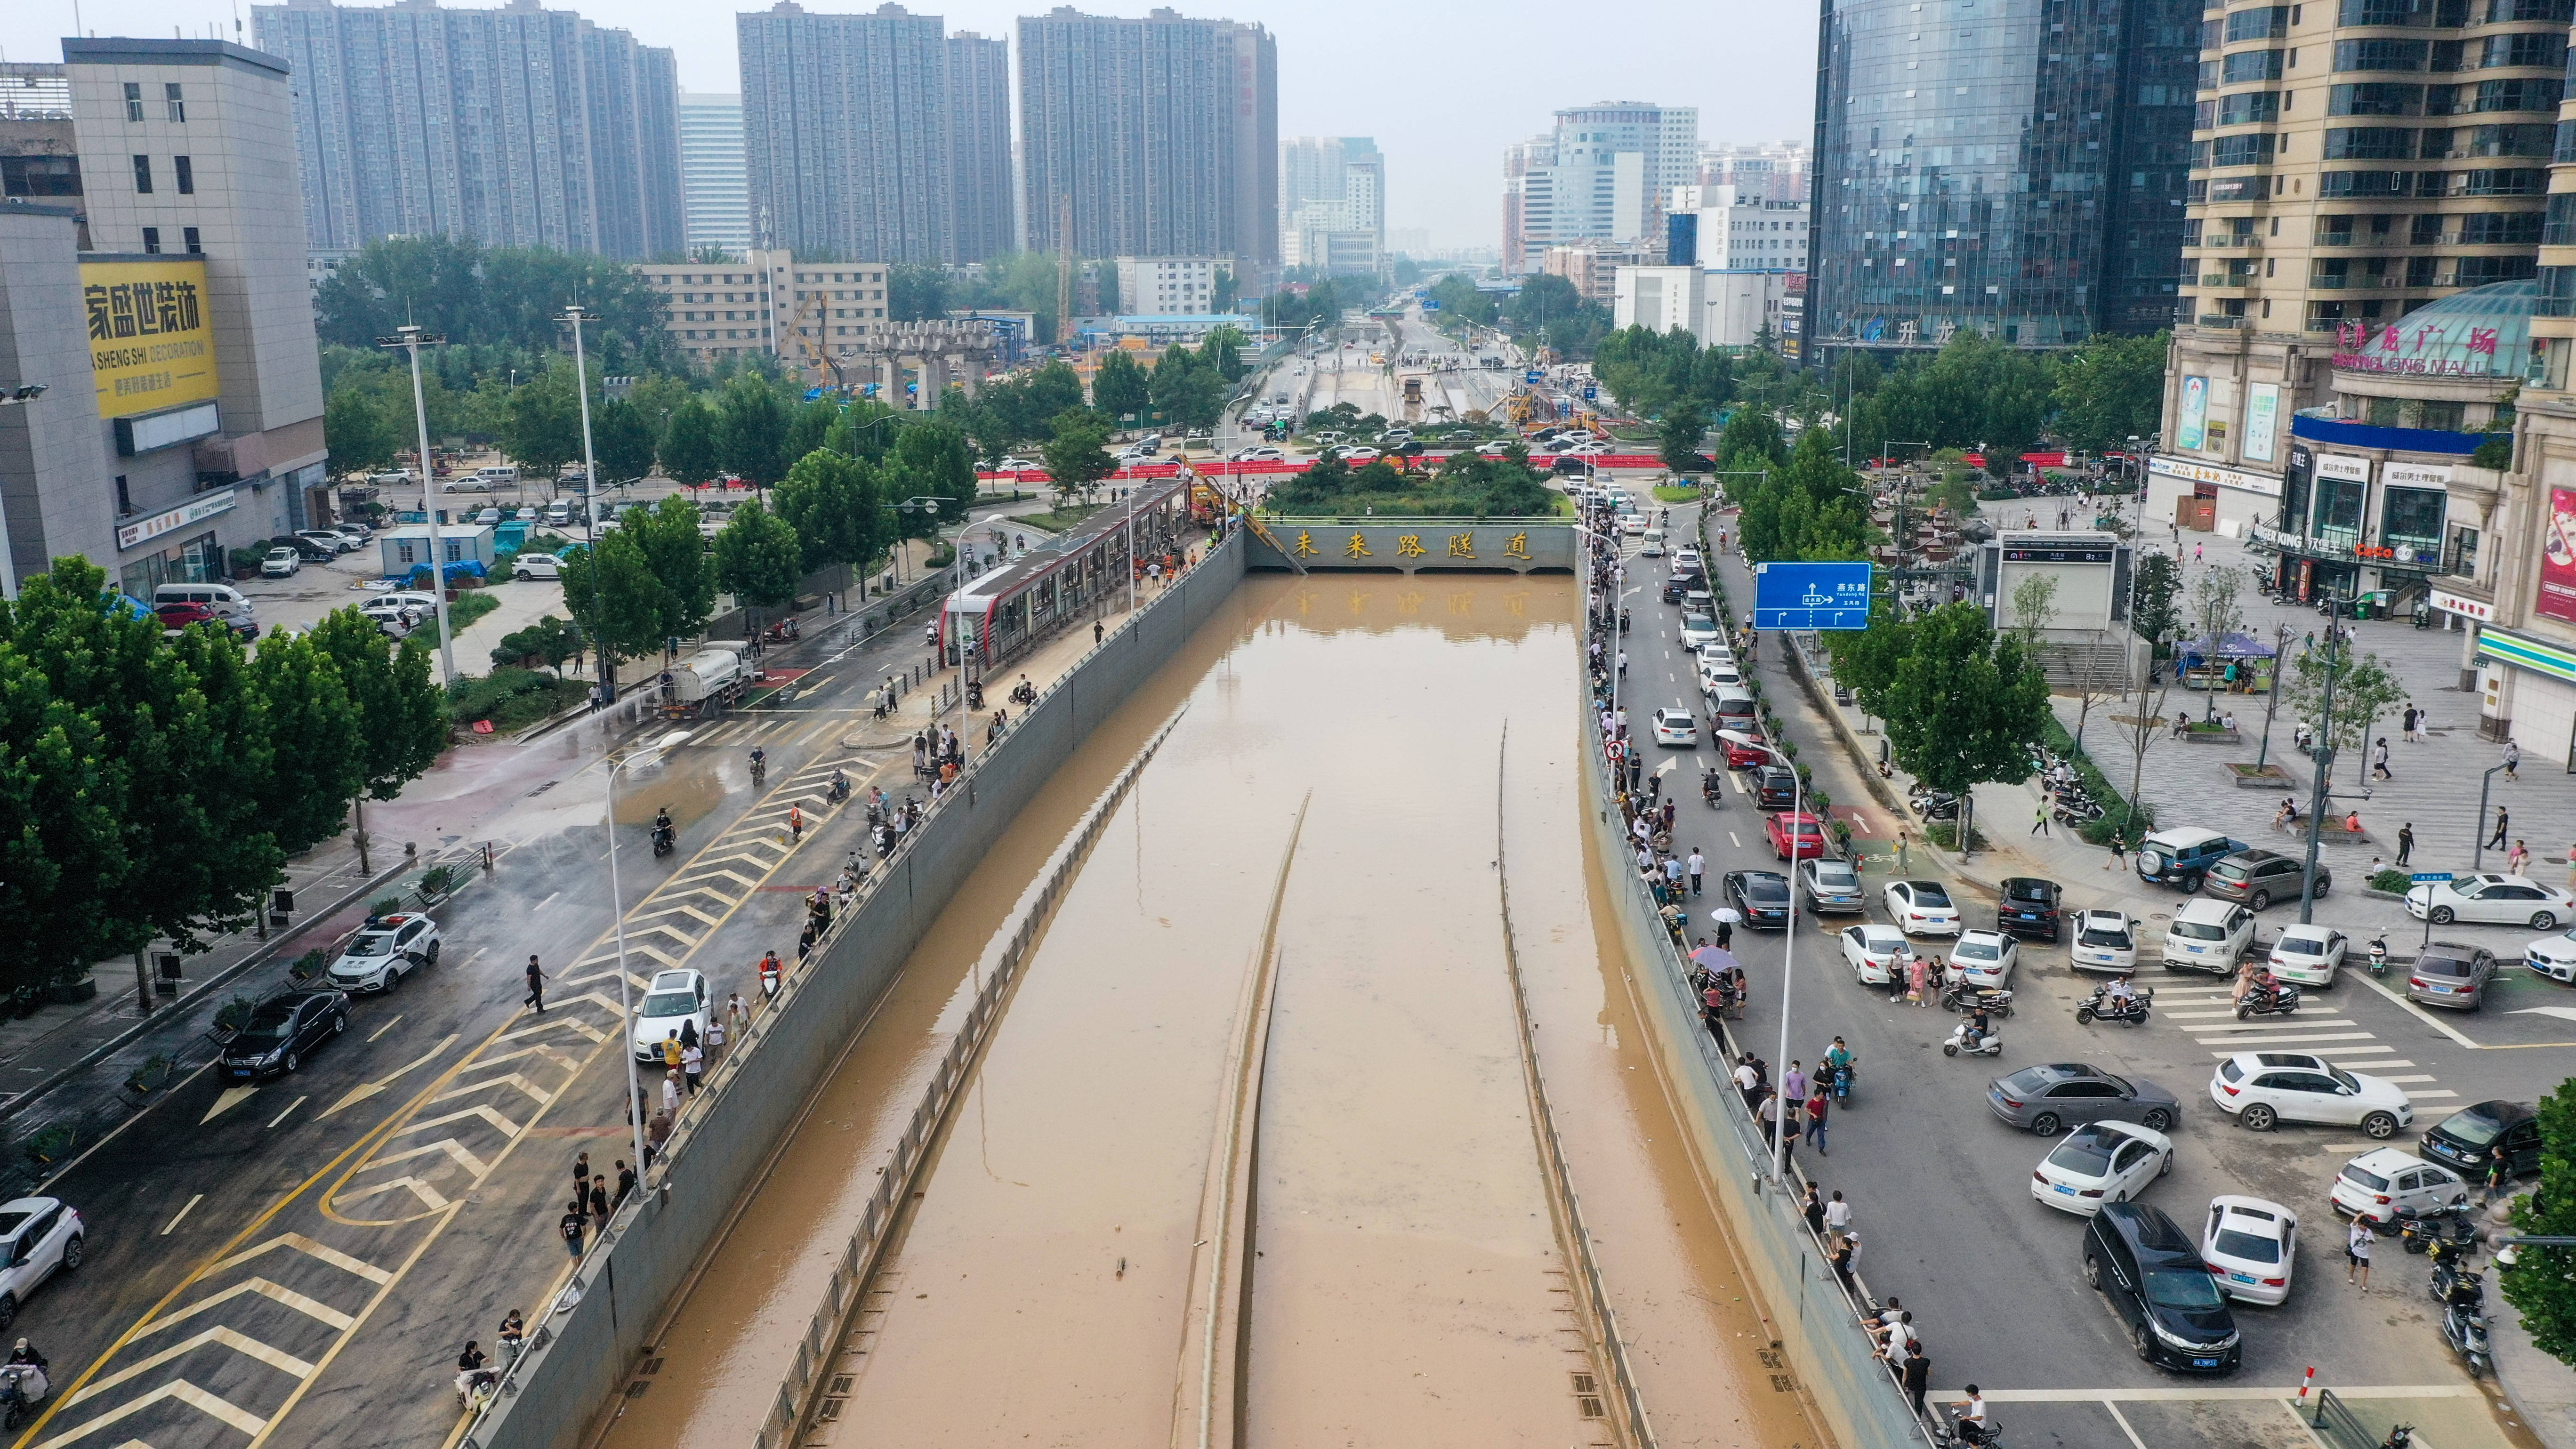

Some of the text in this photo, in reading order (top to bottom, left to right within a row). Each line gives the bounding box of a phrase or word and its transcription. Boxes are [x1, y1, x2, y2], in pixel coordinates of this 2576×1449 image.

[84, 281, 200, 341] 家盛世装饰
[1898, 320, 2037, 345] 升龙大厦
[97, 349, 130, 370] SHENG
[132, 347, 147, 366] SHI
[150, 339, 204, 362] DECORATION
[2431, 359, 2486, 375] MALL
[1293, 530, 1532, 560] 未来路隧道
[2254, 523, 2302, 548] BURGER KING
[2308, 537, 2341, 554] 汉堡王
[2354, 544, 2395, 558] CoCo
[1837, 583, 1866, 592] 燕东路
